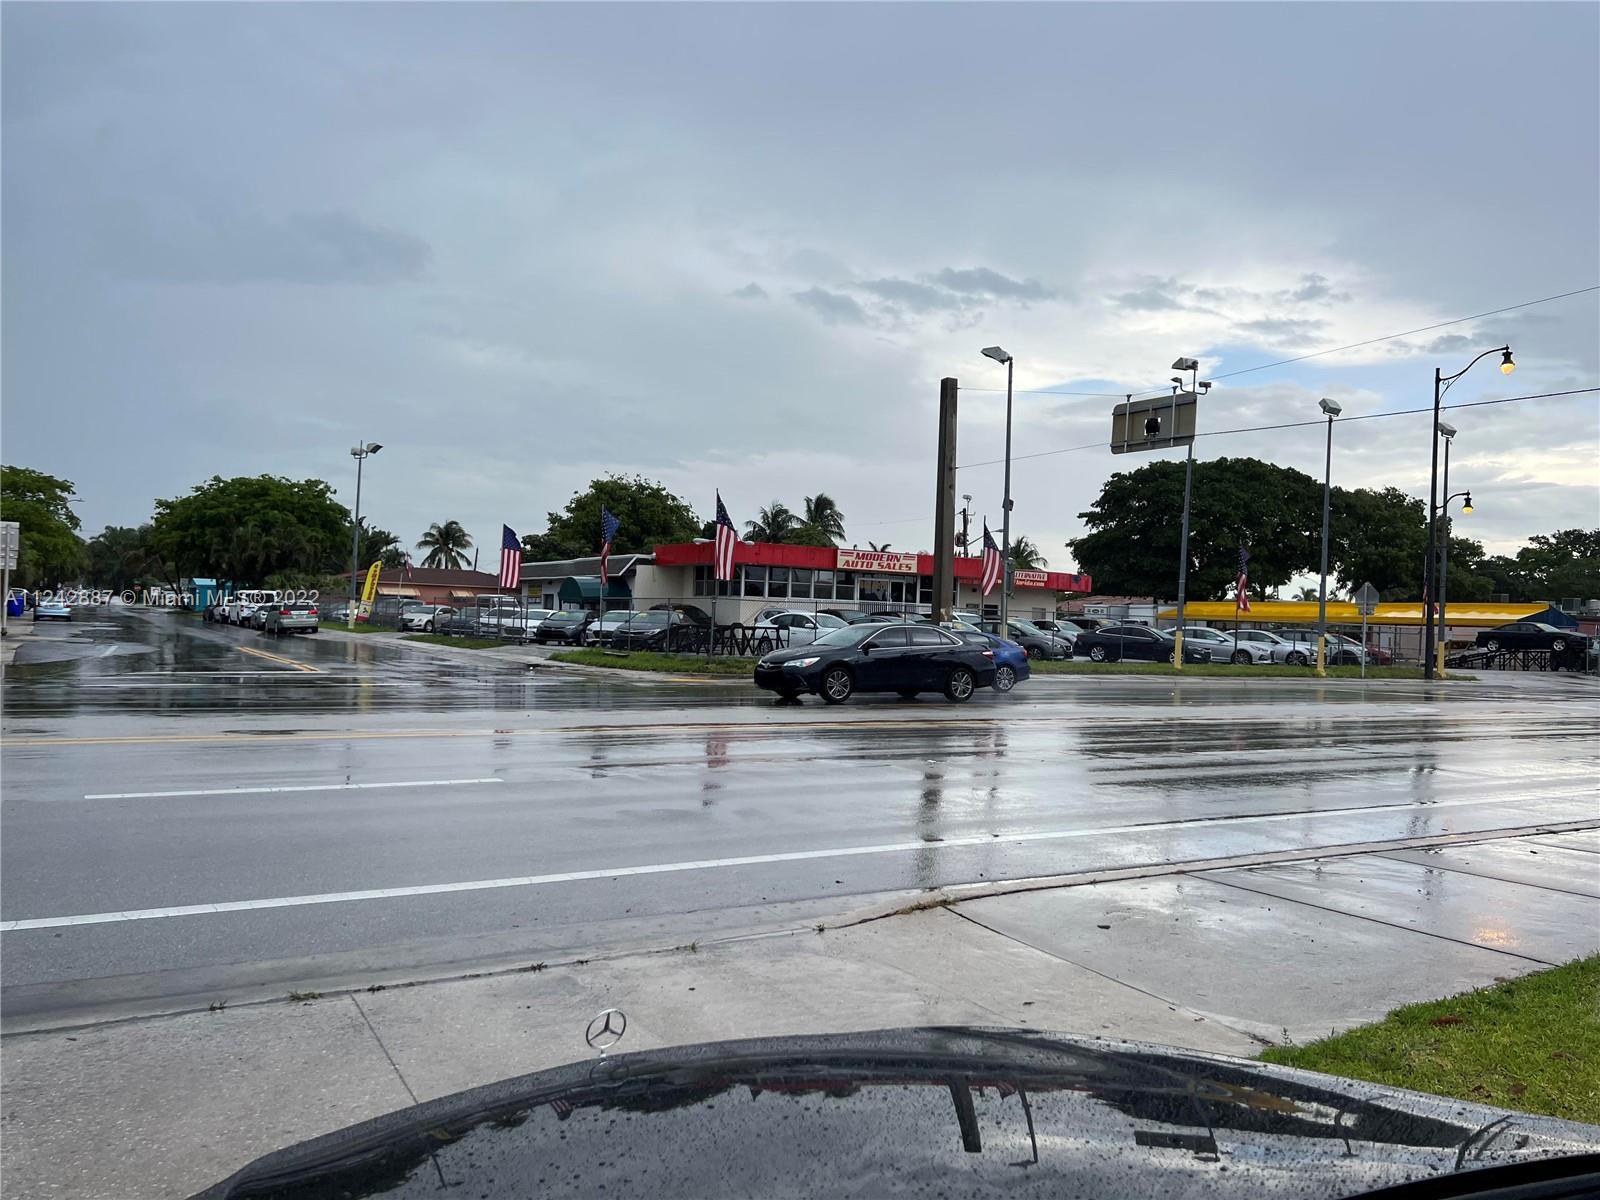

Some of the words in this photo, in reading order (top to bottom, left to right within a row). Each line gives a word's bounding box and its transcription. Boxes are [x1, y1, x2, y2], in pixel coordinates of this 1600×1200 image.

[854, 552, 902, 562] MODERN
[842, 560, 873, 568] AUTO
[877, 562, 912, 571] SALES
[1015, 572, 1045, 580] LTERNATIVE
